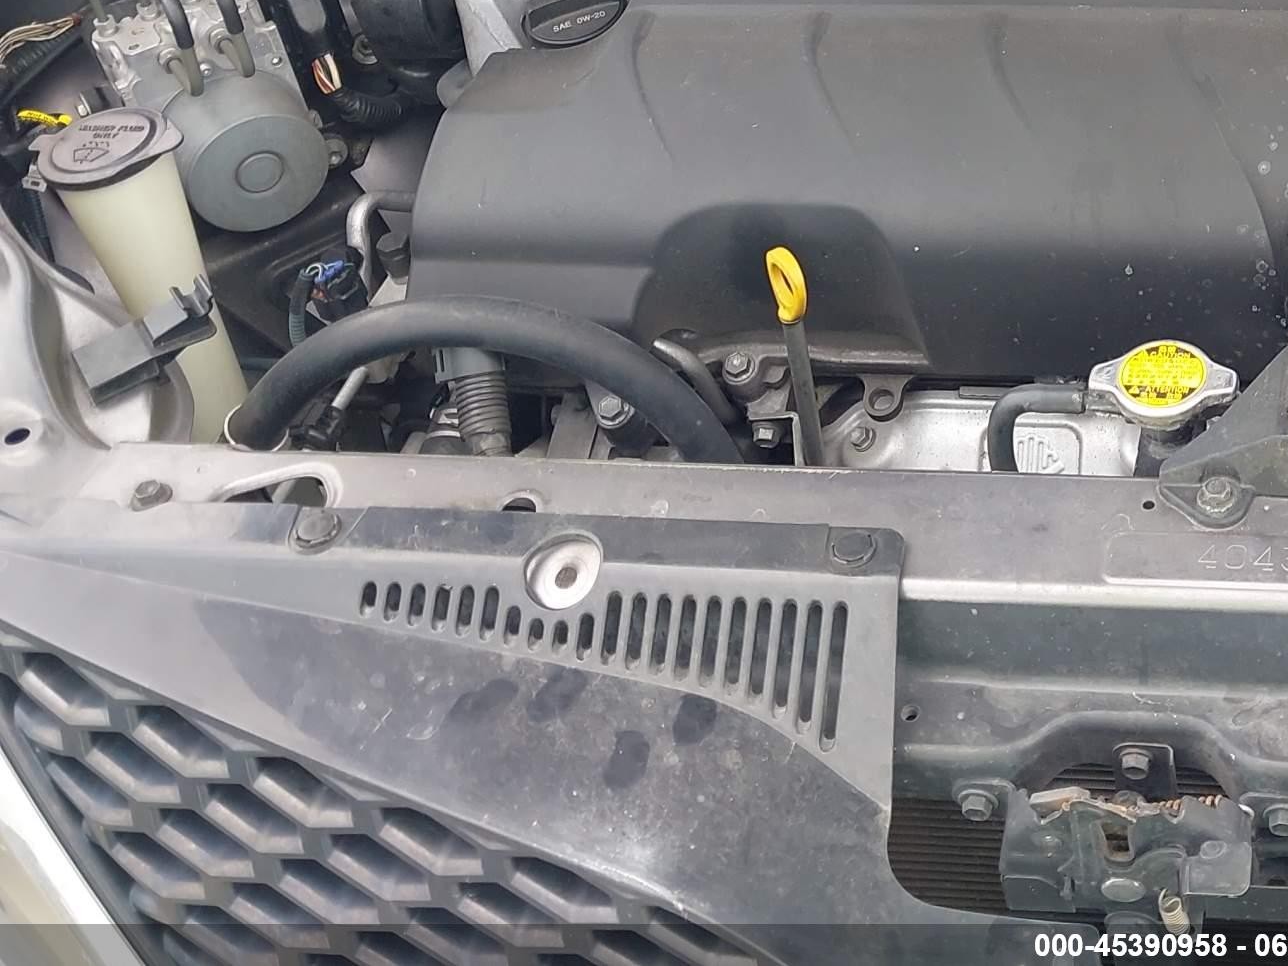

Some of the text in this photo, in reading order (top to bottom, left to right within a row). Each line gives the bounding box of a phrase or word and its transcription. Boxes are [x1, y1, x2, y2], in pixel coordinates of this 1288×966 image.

[553, 10, 606, 33] SAE 0W-20
[1145, 385, 1190, 394] ATTENTION
